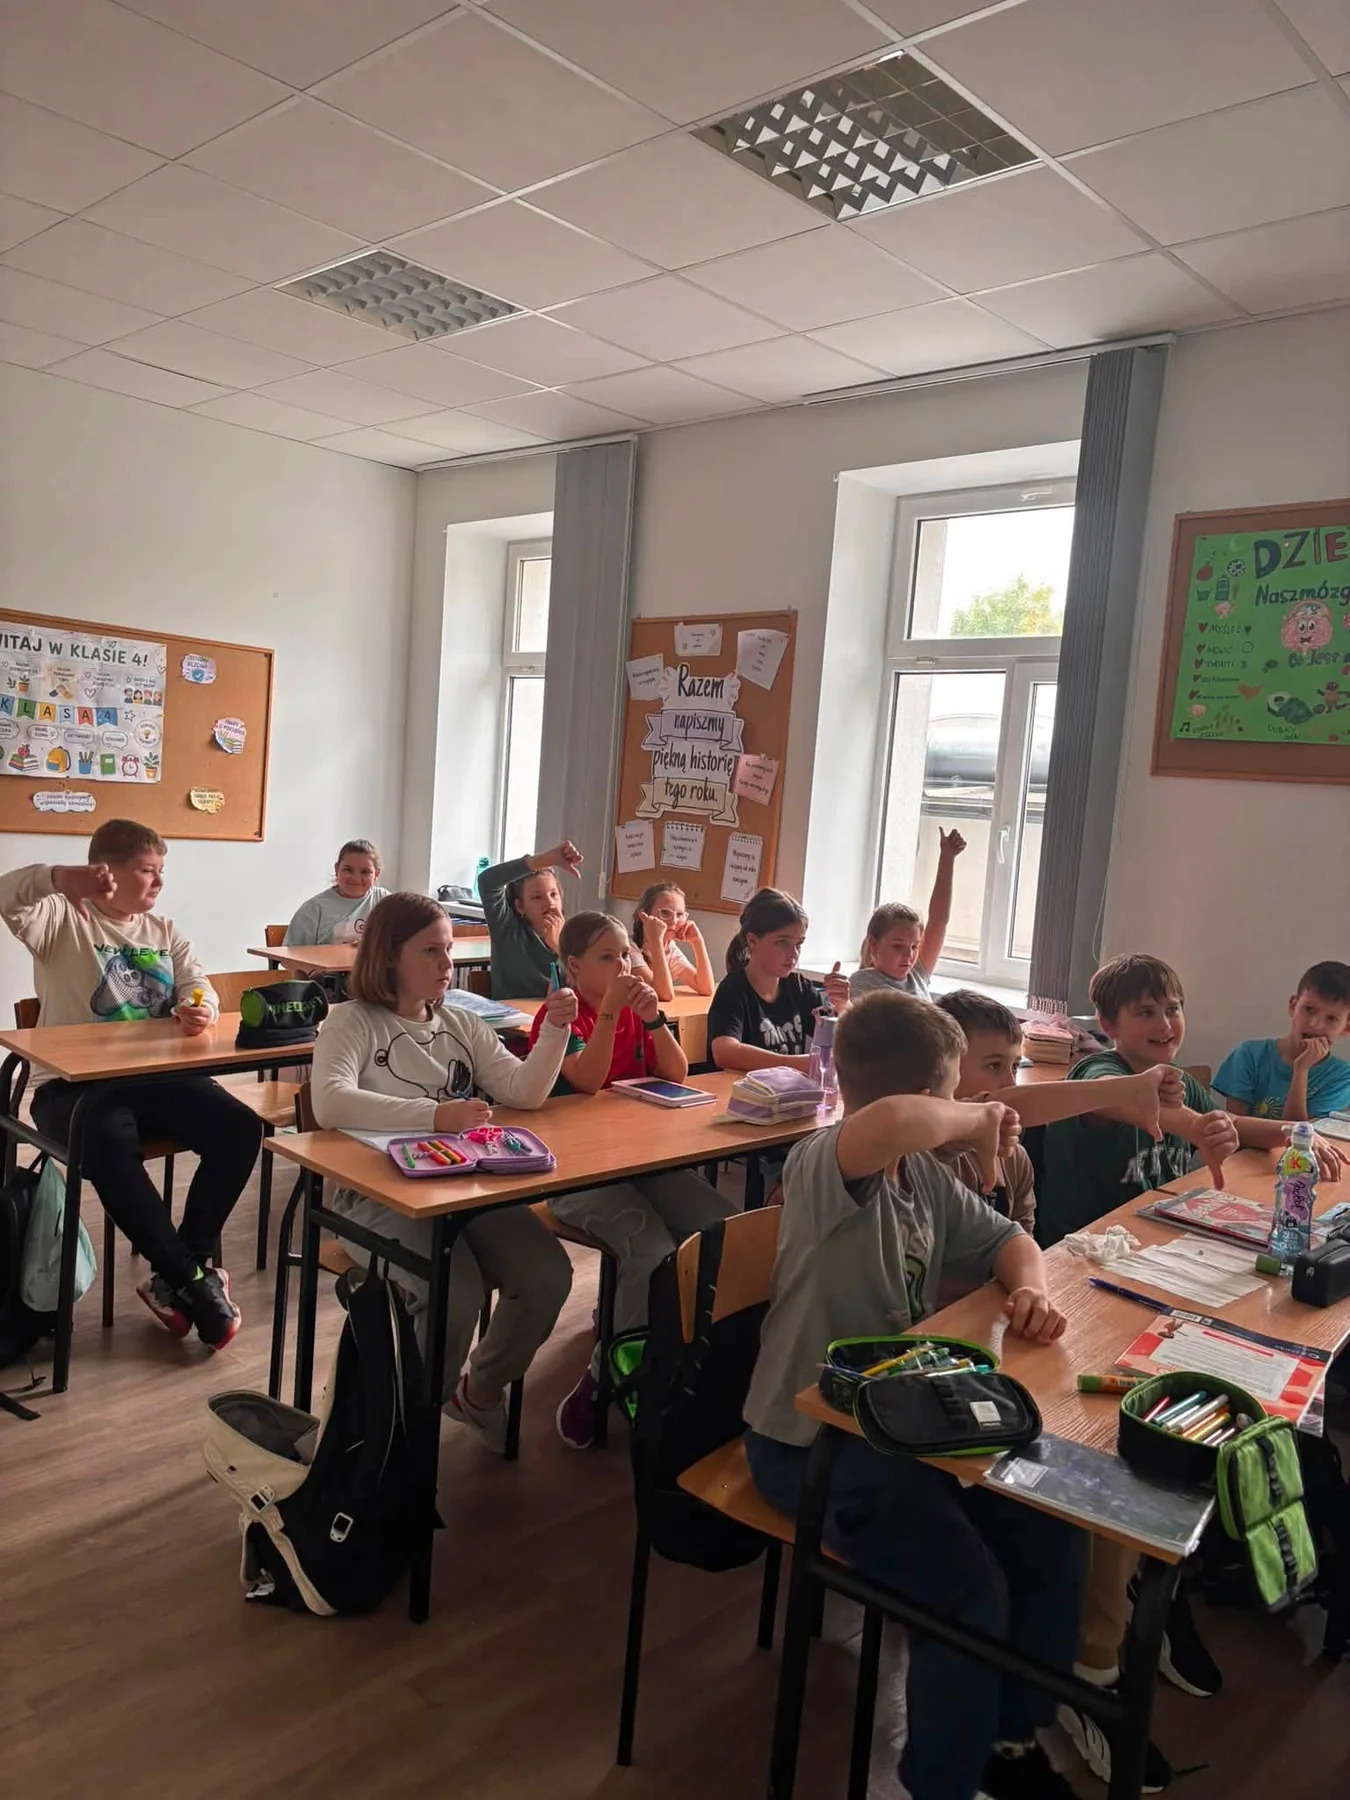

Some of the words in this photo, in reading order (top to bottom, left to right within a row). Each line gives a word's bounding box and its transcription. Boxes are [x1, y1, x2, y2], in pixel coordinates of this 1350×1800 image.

[49, 641, 63, 655] W
[70, 644, 127, 664] KLASIE
[132, 652, 148, 667] 4!
[678, 664, 725, 699] Razem
[103, 710, 112, 720] 4
[674, 713, 725, 740] napiszmy
[654, 741, 686, 773] piękną
[690, 745, 733, 776] historię
[665, 777, 687, 809] tego
[690, 777, 718, 802] roku.
